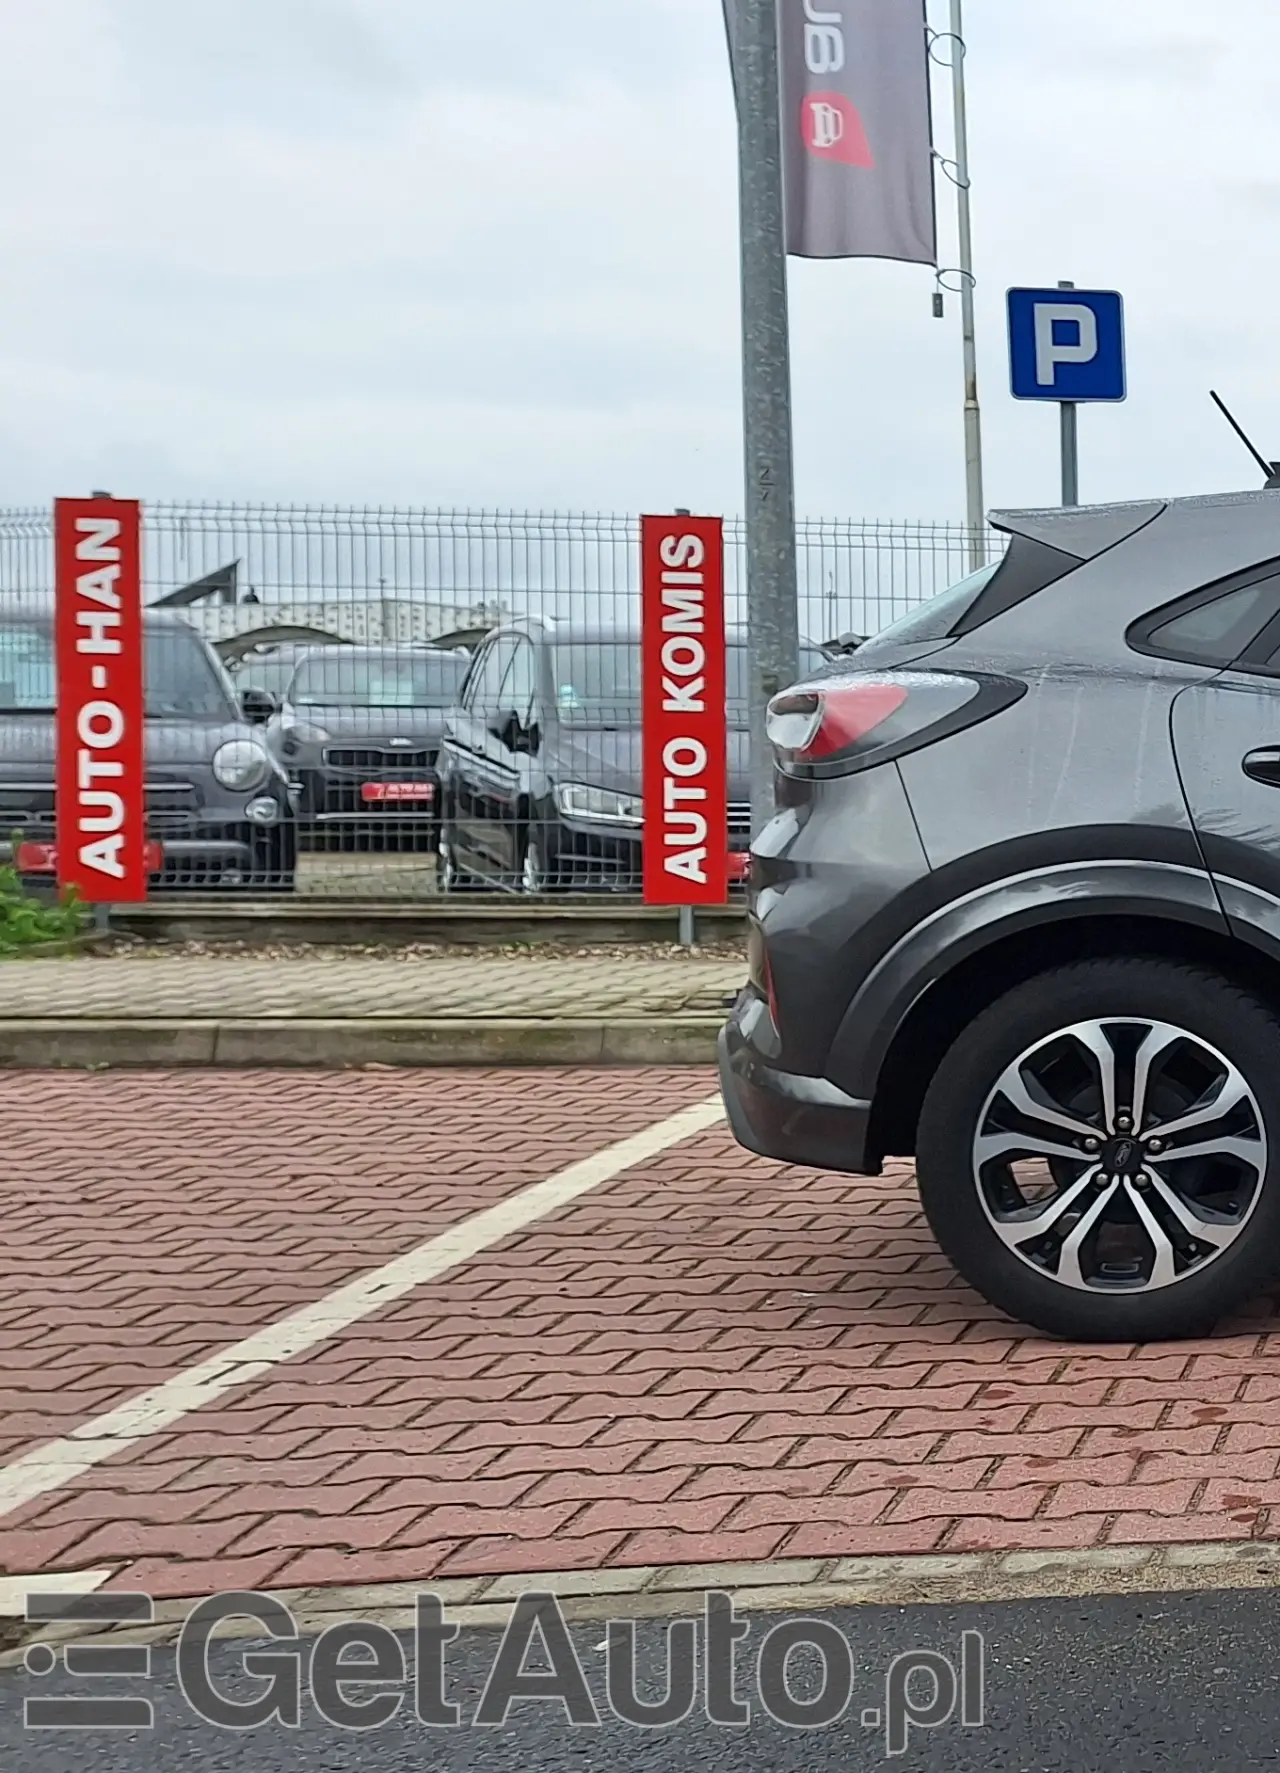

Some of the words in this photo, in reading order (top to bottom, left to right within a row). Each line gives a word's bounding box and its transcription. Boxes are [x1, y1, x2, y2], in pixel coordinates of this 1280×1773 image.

[1033, 302, 1098, 386] P
[77, 517, 124, 878] AUTO-HAN
[660, 534, 705, 712] KOMIS
[662, 737, 707, 884] AUTO
